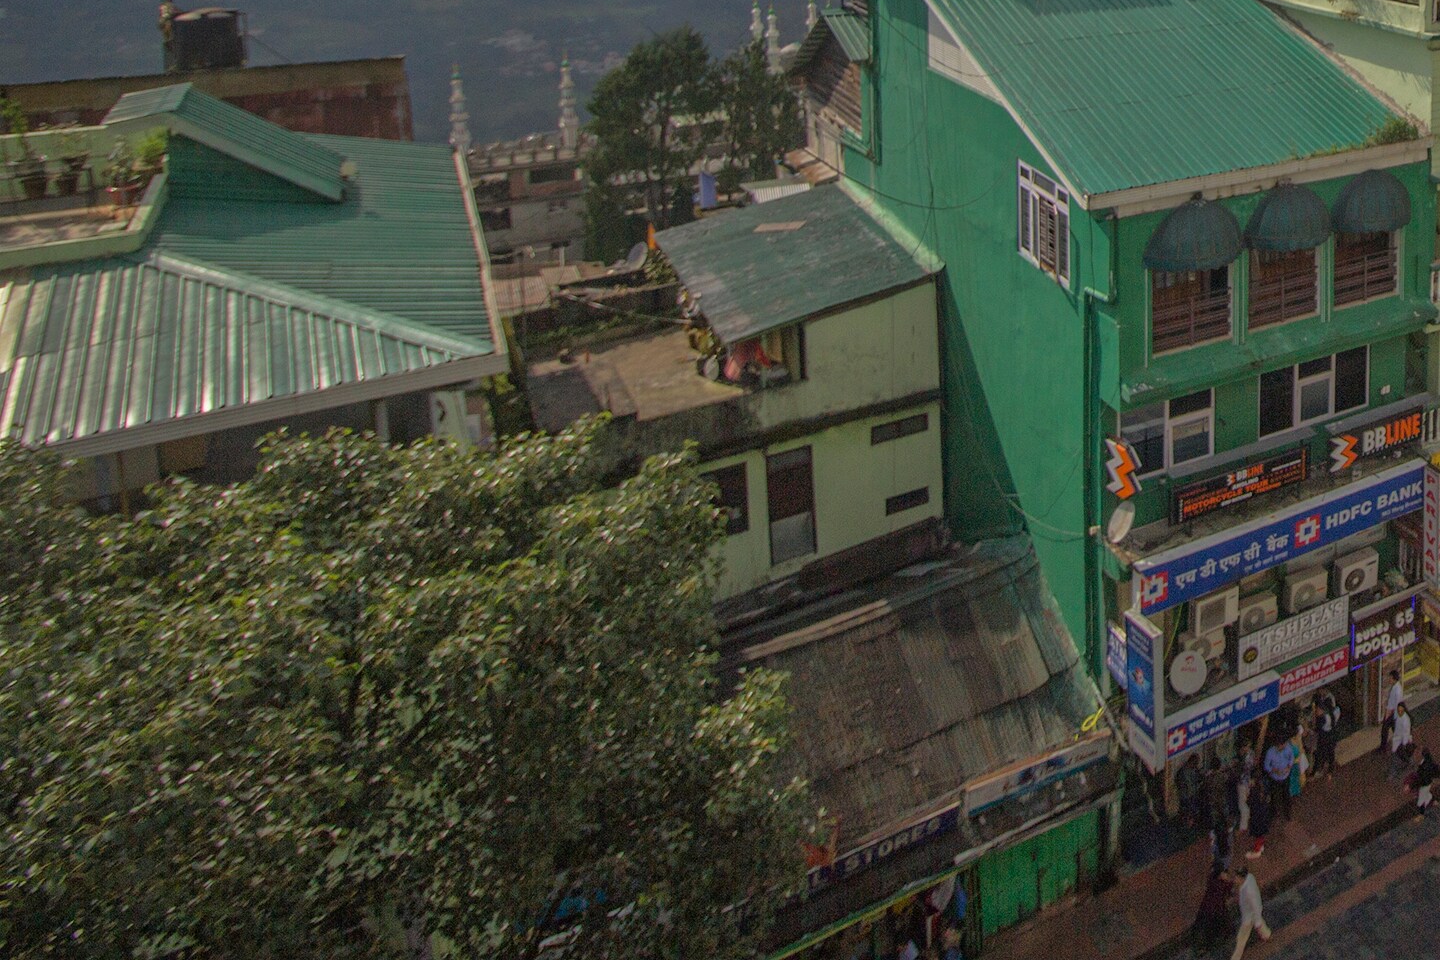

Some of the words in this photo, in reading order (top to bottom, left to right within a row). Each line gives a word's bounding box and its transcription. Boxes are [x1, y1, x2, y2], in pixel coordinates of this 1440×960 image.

[1362, 412, 1421, 453] BBLINE
[1236, 463, 1264, 481] BBLINE
[1183, 487, 1243, 513] MOTORCYCLE
[1325, 499, 1373, 530] HDFC
[1376, 479, 1423, 510] BANK
[1425, 473, 1436, 578] PARIVAR
[1354, 633, 1390, 659] FOOD
[1382, 631, 1415, 654] CLUB
[1282, 664, 1336, 695] Restaurant
